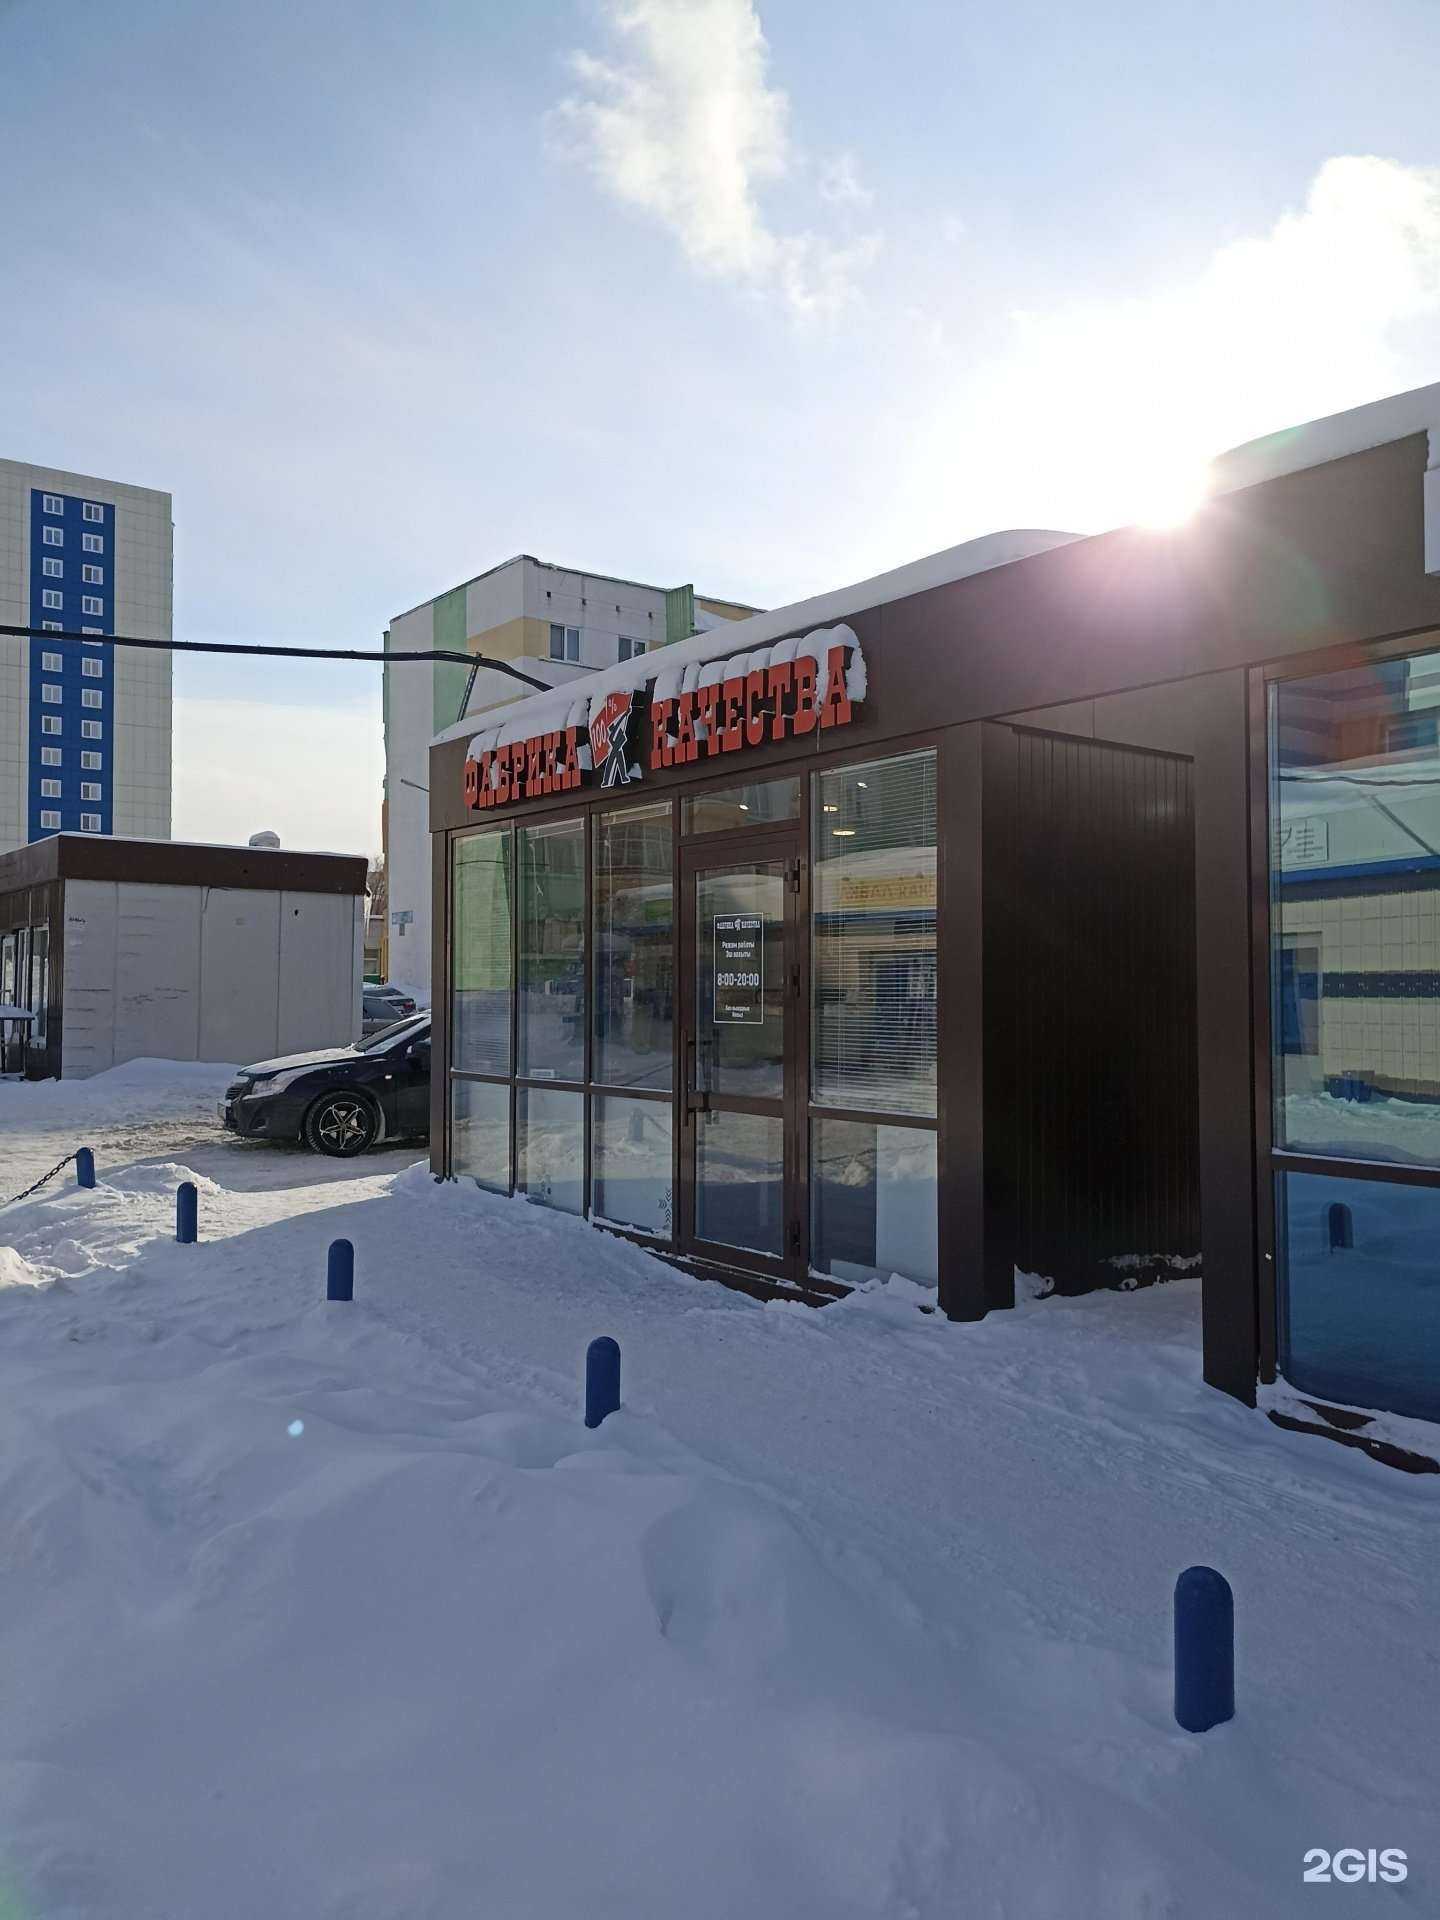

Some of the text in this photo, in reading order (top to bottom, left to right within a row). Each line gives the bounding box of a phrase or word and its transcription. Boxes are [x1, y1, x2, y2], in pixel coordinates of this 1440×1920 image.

[464, 646, 852, 808] ФАБРИКА КАЧЕСТВА
[717, 973, 759, 986] 8:00-20:00
